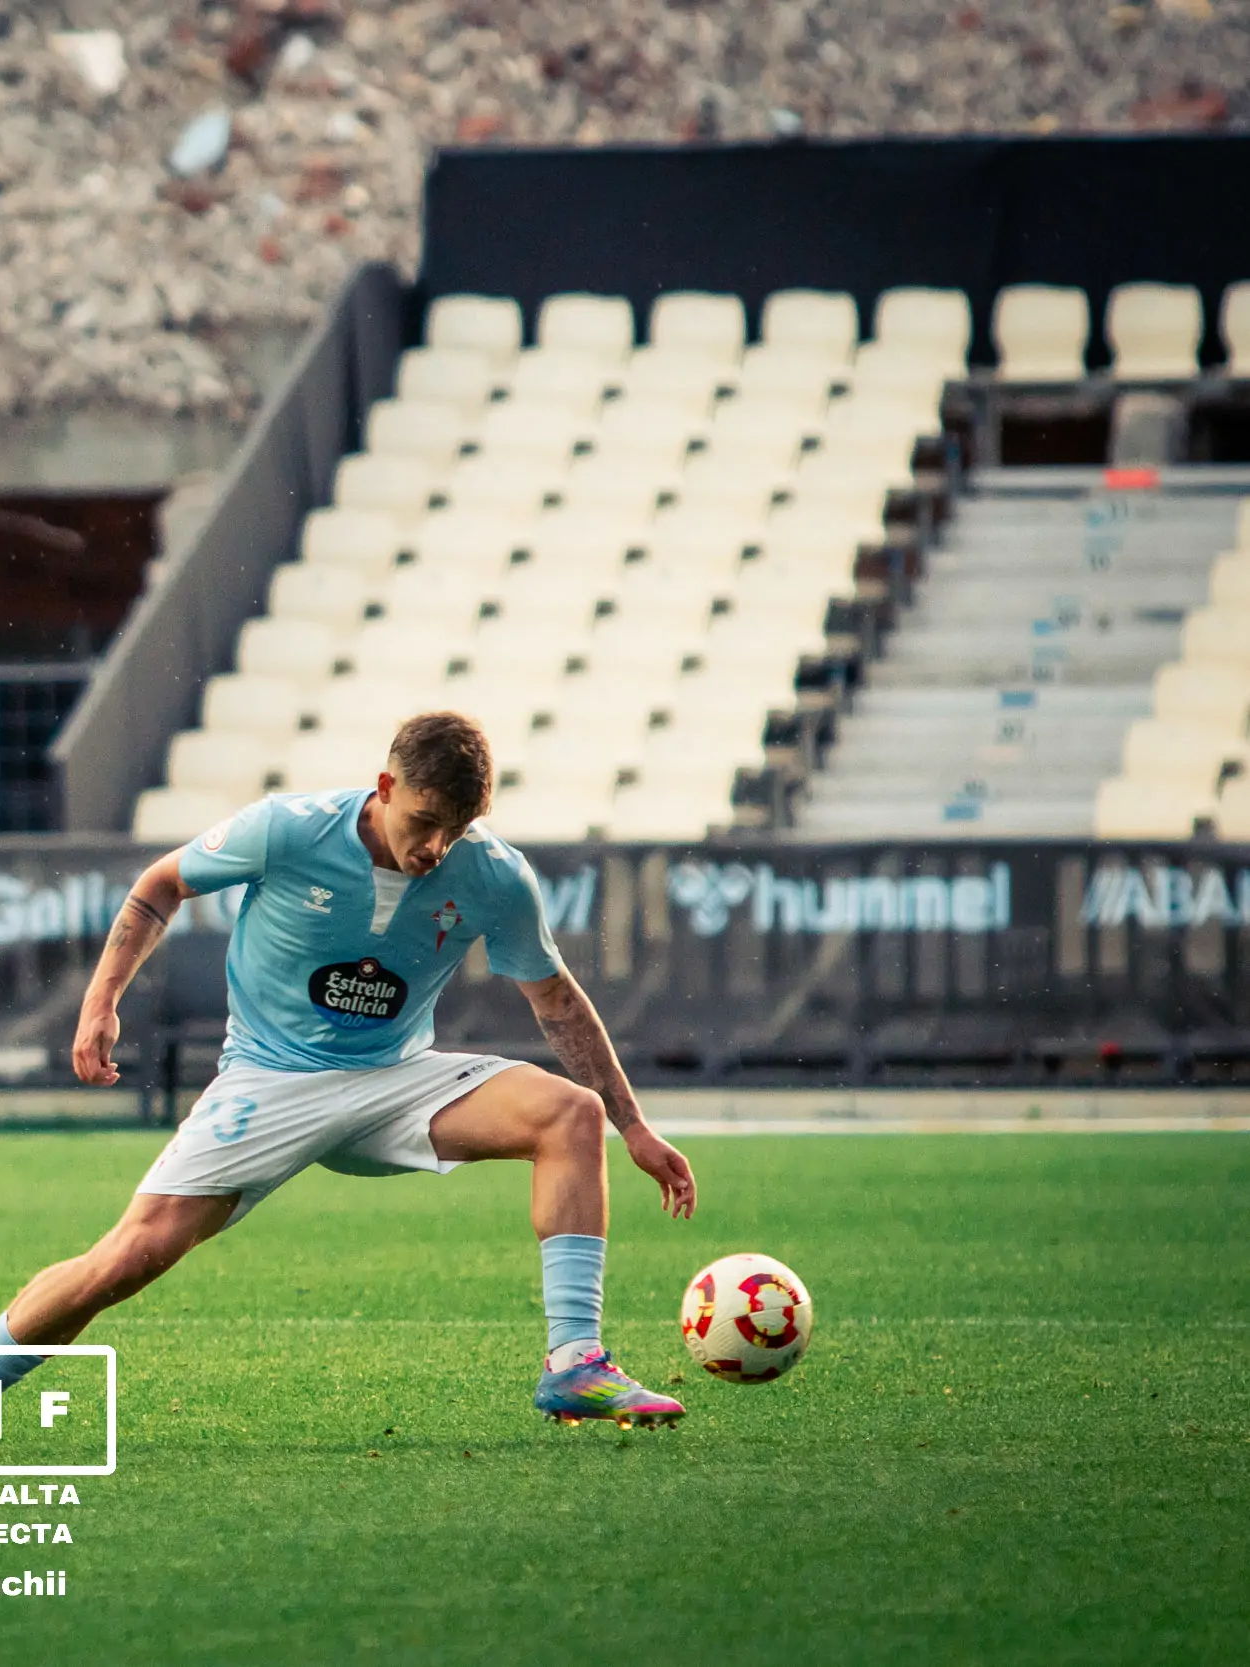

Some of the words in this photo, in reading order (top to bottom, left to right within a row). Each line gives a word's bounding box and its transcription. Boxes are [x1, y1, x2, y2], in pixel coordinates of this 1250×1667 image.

[753, 861, 1012, 933] hummel
[1114, 866, 1250, 928] ABA
[325, 988, 389, 1016] Galicia
[326, 971, 397, 999] Estrella
